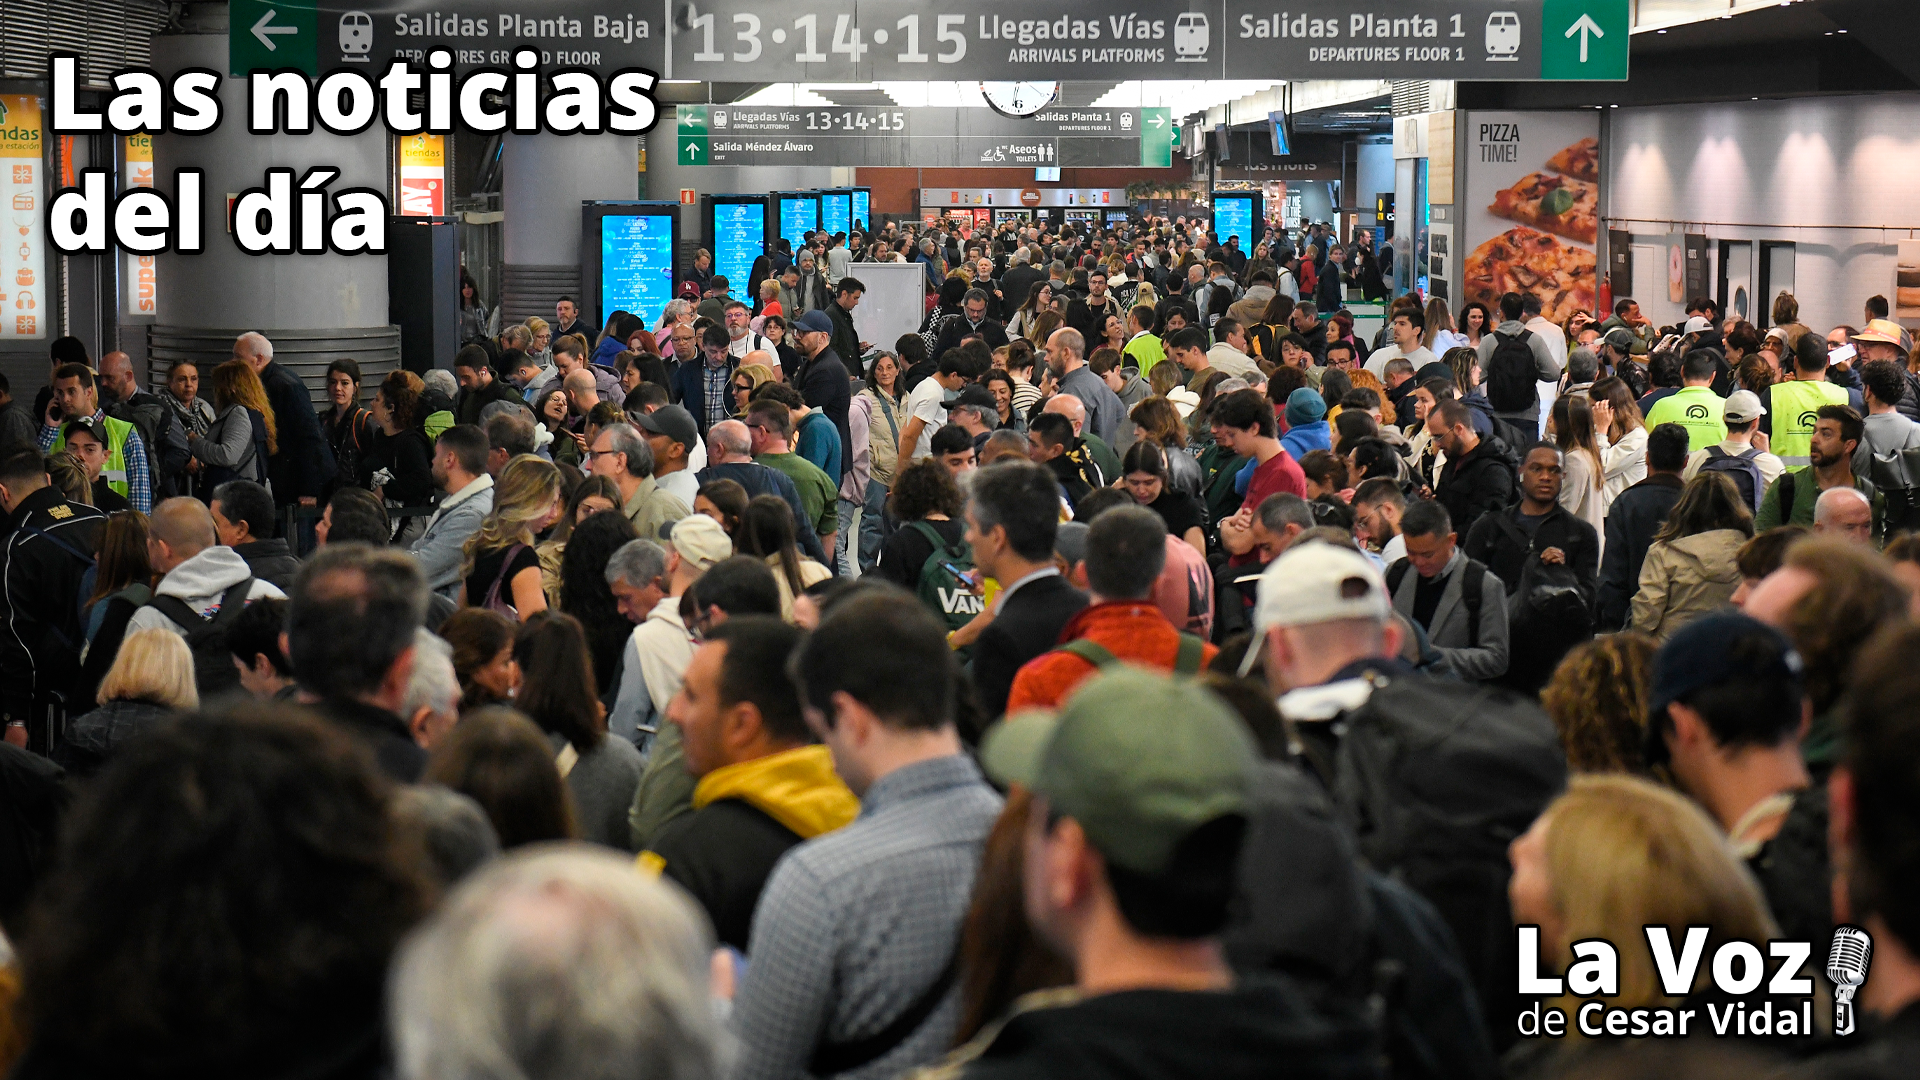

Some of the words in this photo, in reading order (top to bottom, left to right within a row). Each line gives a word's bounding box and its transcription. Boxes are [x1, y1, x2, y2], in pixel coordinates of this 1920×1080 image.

[395, 13, 490, 37] Salidas
[499, 14, 582, 38] Planta
[594, 14, 650, 43] Baja
[979, 14, 1100, 45] Llegadas
[1109, 12, 1165, 39] Vías
[1239, 12, 1339, 38] Salidas
[1350, 13, 1438, 38] Planta
[1450, 13, 1466, 37] 1
[395, 49, 485, 64] DEPRES
[490, 50, 551, 65] GRD
[556, 50, 600, 65] FLOOR
[1008, 48, 1077, 62] ARRIVALS
[1082, 48, 1165, 62] PLATFORMS
[1309, 46, 1400, 61] DEPARTURES
[1405, 46, 1450, 61] FLOOR
[1455, 46, 1465, 61] 1
[733, 111, 778, 123] Llegadas
[780, 111, 800, 122] Vías
[1035, 111, 1069, 121] Salidas
[1071, 112, 1102, 121] Planta
[1105, 112, 1112, 121] 1
[1479, 123, 1520, 142] PIZZA
[405, 149, 440, 157] tiendas
[713, 142, 742, 151] Salida
[745, 141, 782, 151] Méndez
[784, 140, 814, 152] Álvaro
[1009, 144, 1037, 154] Aseos
[1479, 144, 1517, 162] TIME!
[937, 586, 986, 615] VAN
